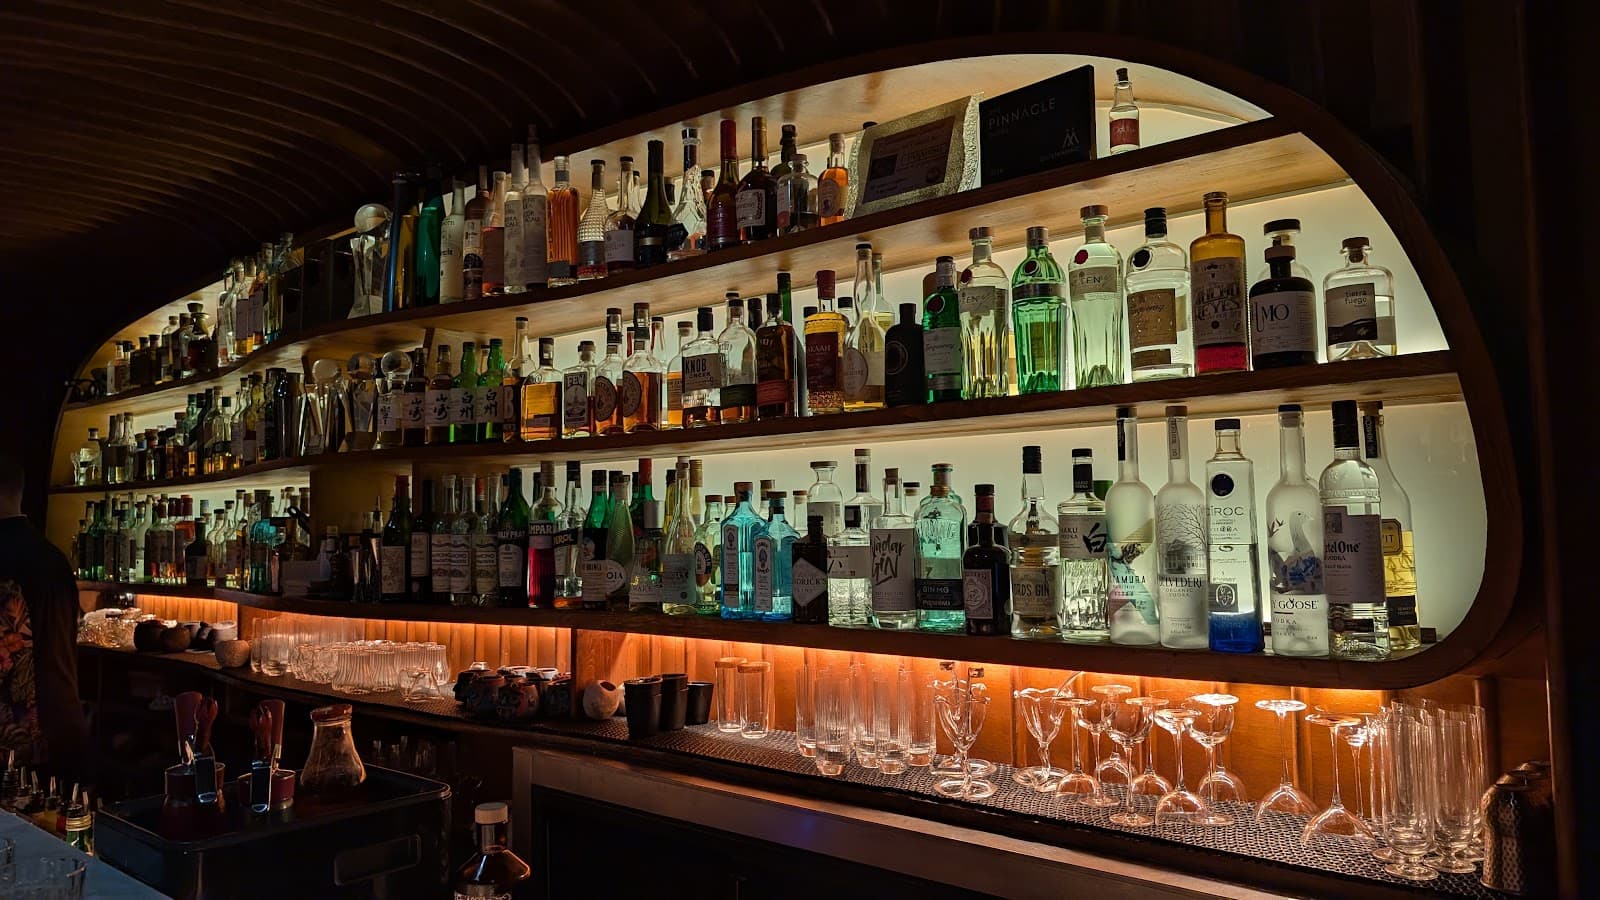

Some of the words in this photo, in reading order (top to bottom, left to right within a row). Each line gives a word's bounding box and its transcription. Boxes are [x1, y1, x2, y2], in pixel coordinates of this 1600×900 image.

[987, 96, 1057, 130] PINNACLE
[685, 357, 707, 375] KNOB
[567, 374, 585, 388] FEW
[1083, 522, 1107, 555] 白
[1338, 540, 1360, 554] One
[1035, 583, 1049, 597] GIN
[1278, 599, 1319, 611] GOOSE
